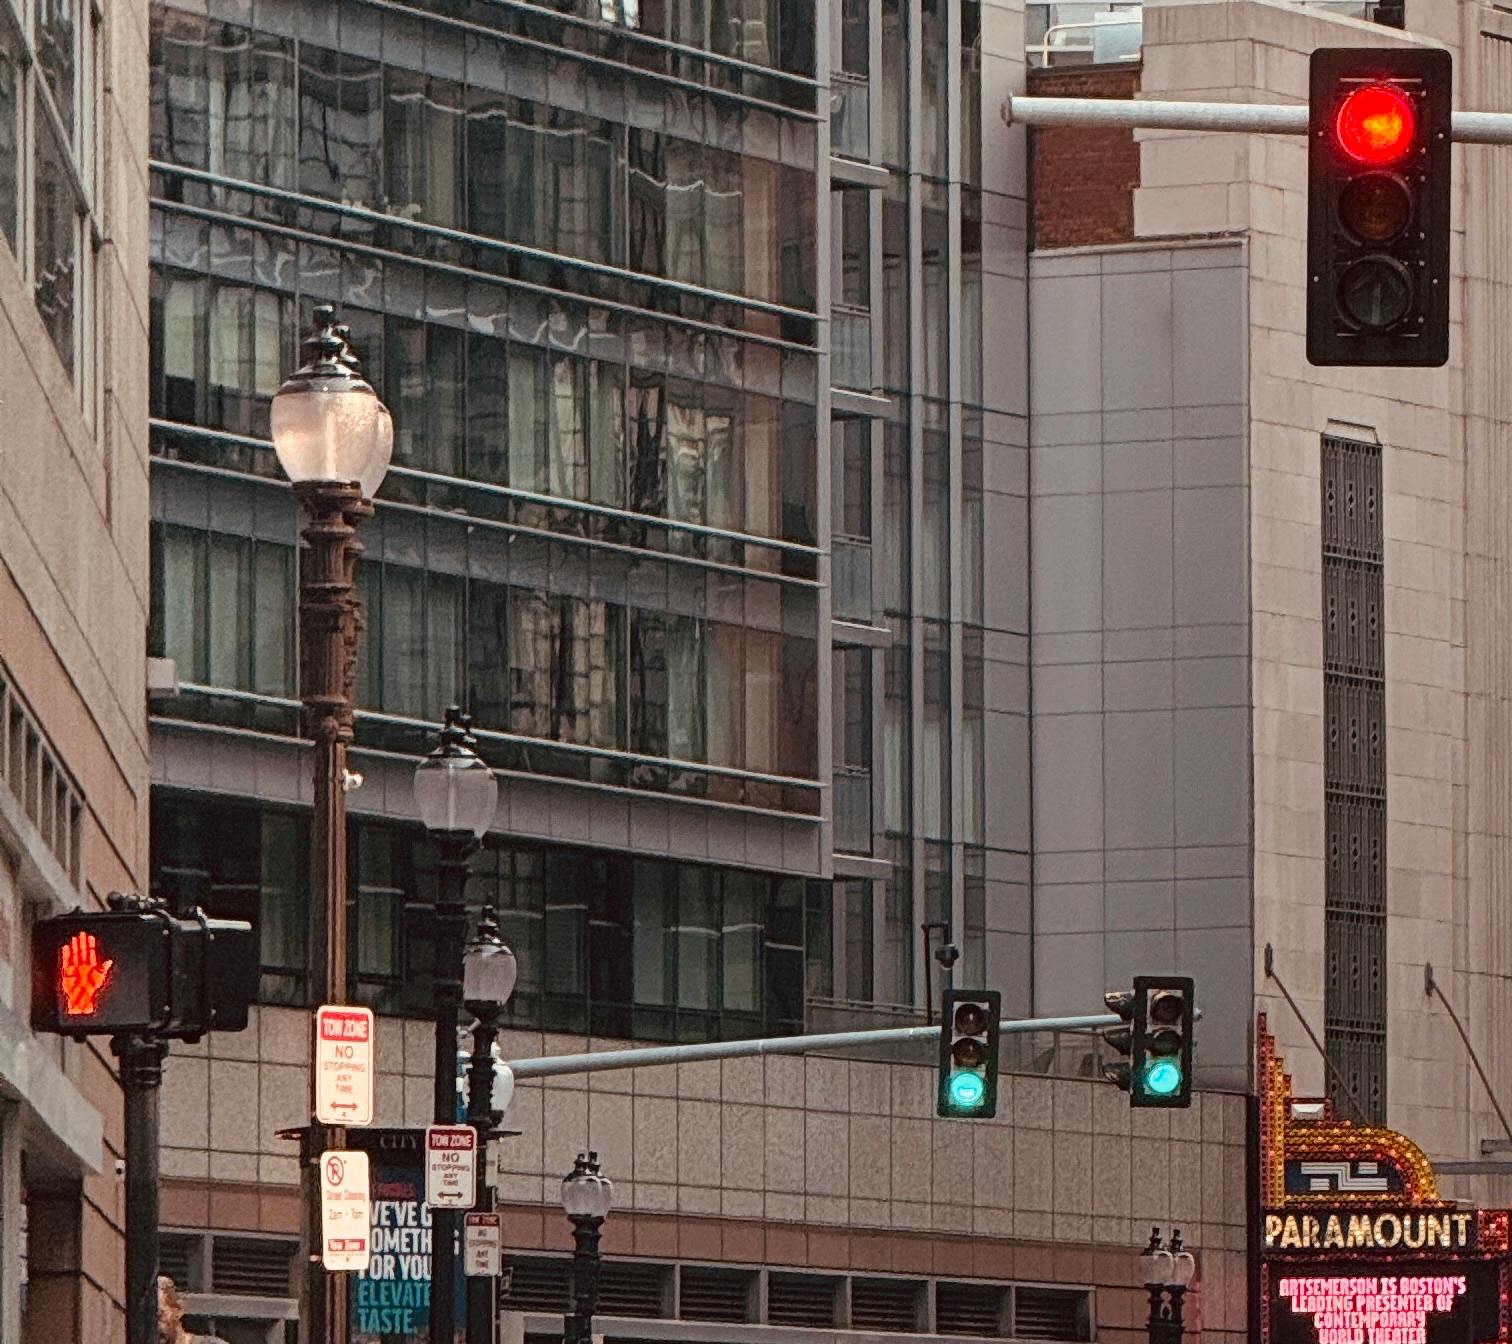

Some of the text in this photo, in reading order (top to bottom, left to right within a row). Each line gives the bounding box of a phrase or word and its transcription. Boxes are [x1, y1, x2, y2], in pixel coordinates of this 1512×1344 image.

[323, 1018, 368, 1039] TOW ZONE
[336, 1045, 354, 1059] NO
[431, 1134, 472, 1147] TOW ZONE
[442, 1152, 460, 1163] NO
[432, 1163, 470, 1172] STOPPING
[1265, 1213, 1472, 1249] PARAMOUNT
[1279, 1276, 1467, 1297] ARTSEMERSON IS BOSTON'S
[1291, 1295, 1454, 1313] LEADING PRESENTER OF
[357, 1308, 418, 1335] TASTE.
[1313, 1311, 1426, 1328] CONTEMPORARY
[1318, 1327, 1427, 1344] WORLD THEATER
